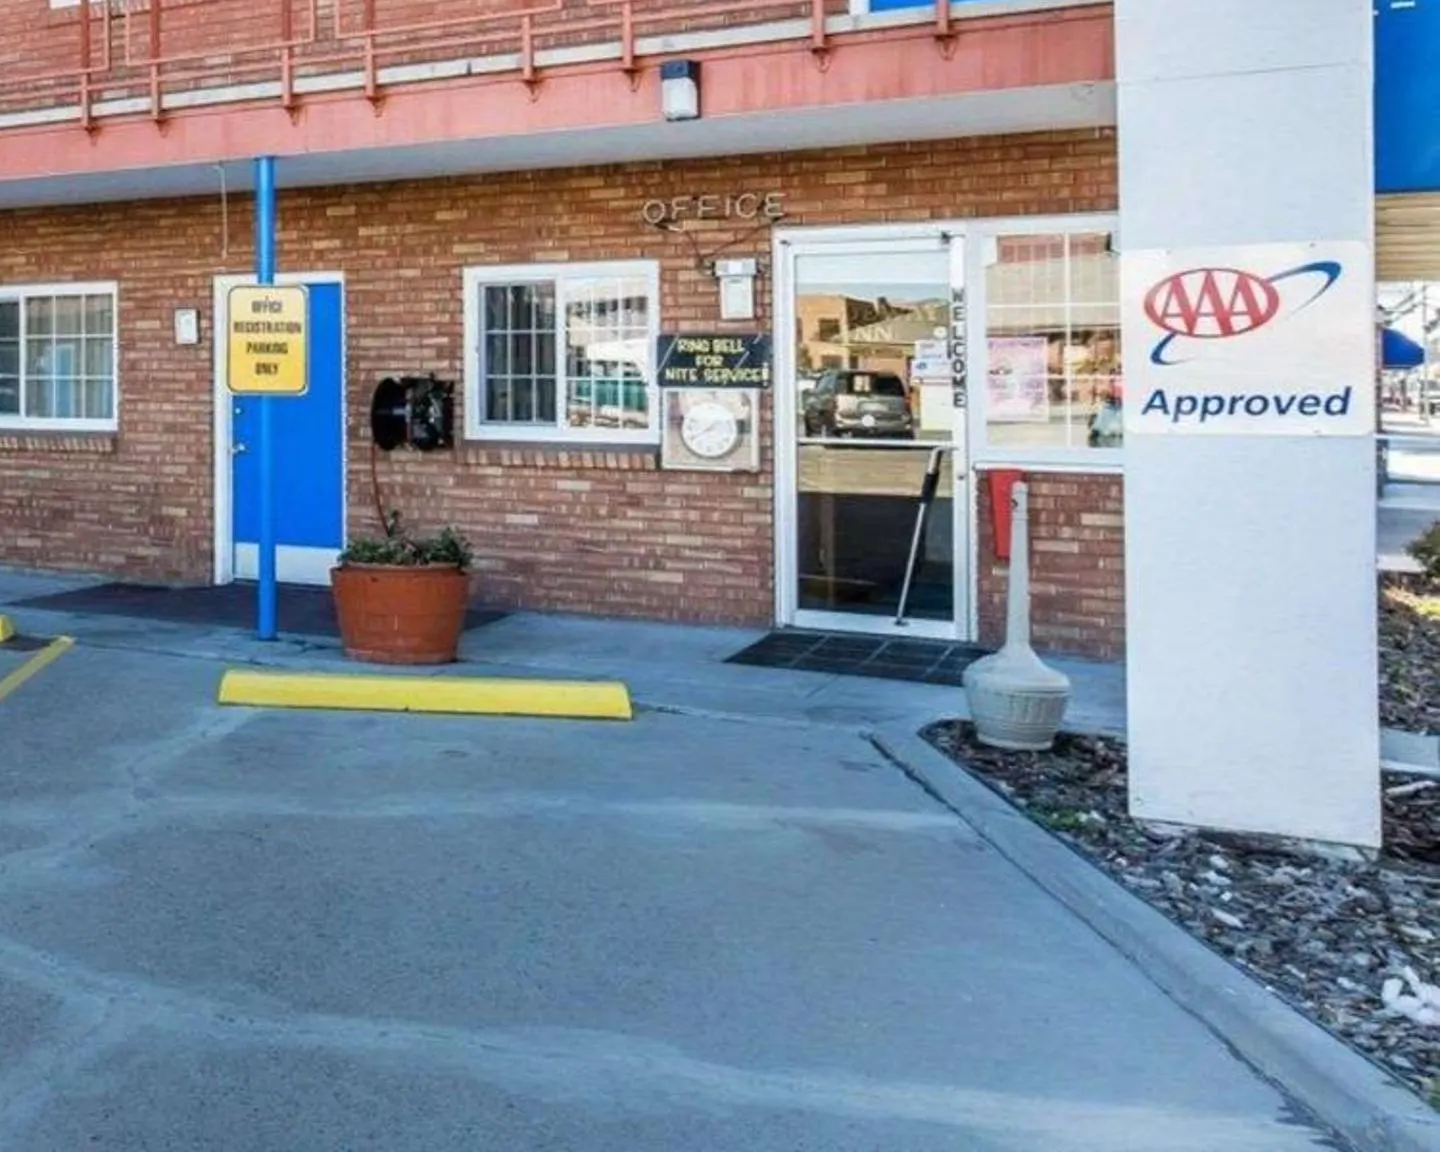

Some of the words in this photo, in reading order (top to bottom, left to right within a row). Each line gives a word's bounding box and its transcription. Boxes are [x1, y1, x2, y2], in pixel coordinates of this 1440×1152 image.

[643, 193, 786, 224] OFFICE
[251, 300, 283, 313] OFFICE
[1158, 271, 1264, 336] AAA
[233, 321, 302, 334] REGISTRATION
[246, 342, 288, 354] PARKING
[677, 338, 710, 353] RING
[712, 338, 746, 354] BELL
[695, 355, 724, 368] FOR
[255, 363, 279, 375] ONLY
[665, 368, 698, 381] NITE
[1141, 386, 1352, 423] Approved
